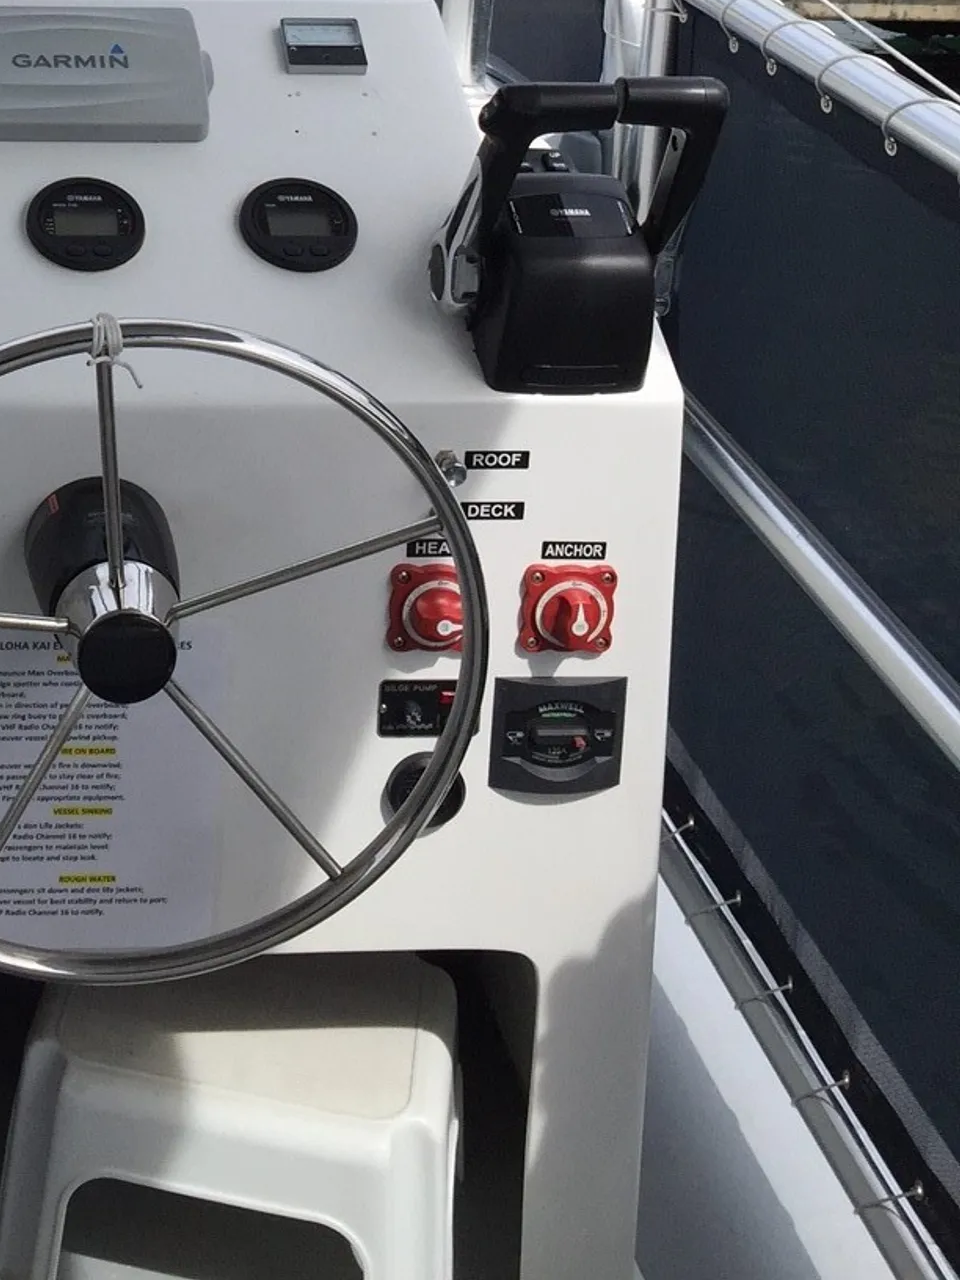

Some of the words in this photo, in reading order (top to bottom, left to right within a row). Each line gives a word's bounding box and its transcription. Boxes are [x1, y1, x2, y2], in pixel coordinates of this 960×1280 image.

[11, 53, 129, 68] GARMIN
[559, 208, 591, 216] YAMAHA
[471, 453, 522, 467] ROOF
[467, 504, 516, 518] DECK
[415, 542, 451, 555] HEA
[544, 543, 603, 558] ANCHOR
[32, 641, 50, 650] KAI
[413, 684, 439, 692] PUMP
[538, 702, 585, 713] MAXWELL
[89, 875, 116, 883] WATER
